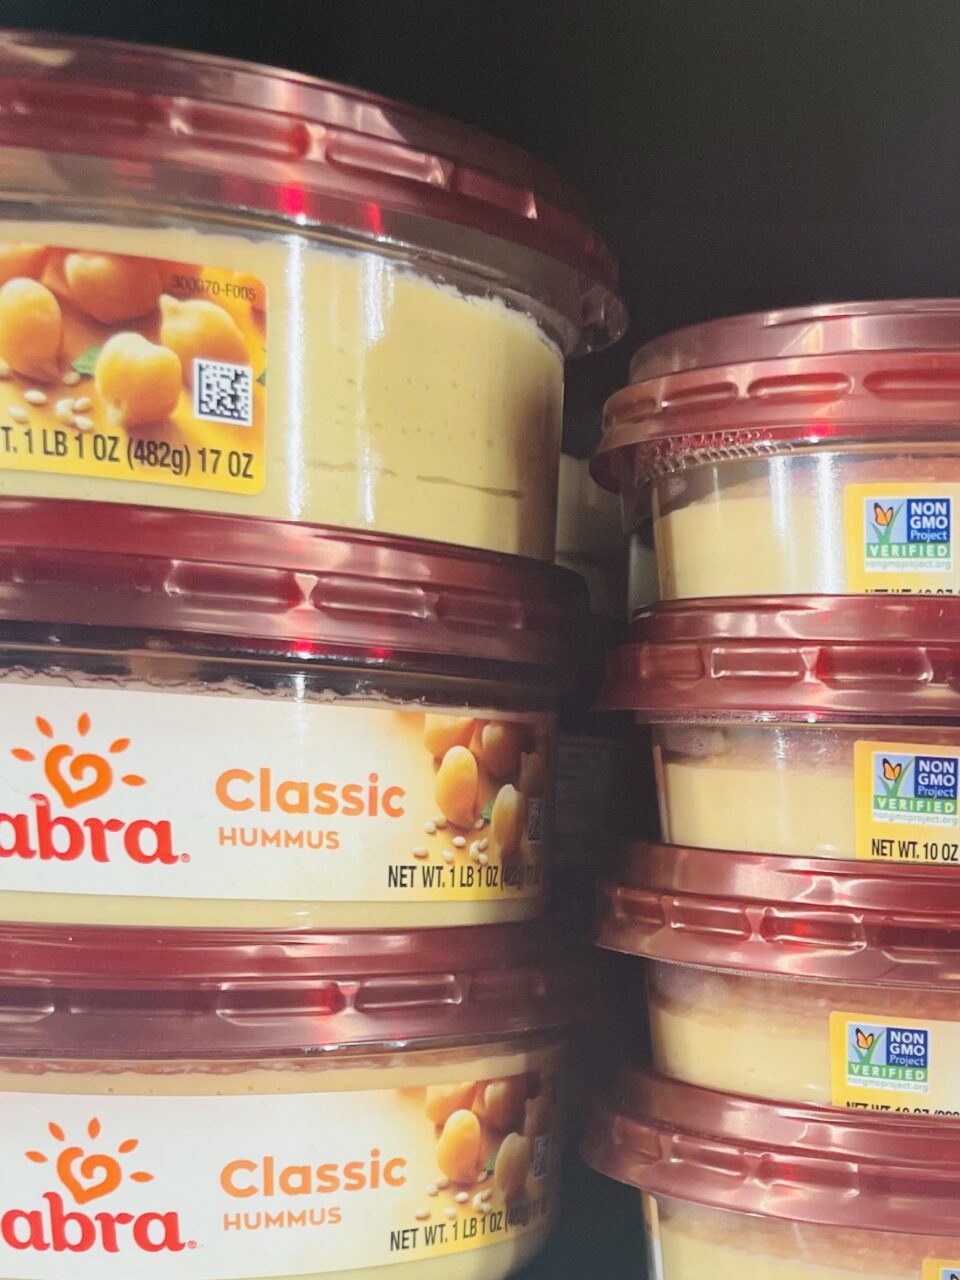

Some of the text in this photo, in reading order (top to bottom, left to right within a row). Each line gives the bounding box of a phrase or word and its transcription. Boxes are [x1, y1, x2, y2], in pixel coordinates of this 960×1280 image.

[42, 430, 254, 479] LB OZ (482g) 17 OZ
[910, 502, 947, 515] NON
[910, 515, 948, 530] GMO
[910, 529, 948, 543] Project
[869, 544, 948, 557] VERIFIED
[919, 760, 954, 773] NON
[918, 774, 955, 787] GMO
[215, 768, 406, 818] Classic
[917, 785, 954, 799] Project
[877, 797, 955, 813] VERIFIED
[0, 793, 182, 865] abra
[218, 826, 340, 850] HUMMUS
[872, 838, 894, 857] NET
[898, 840, 920, 859] WT.
[923, 842, 938, 860] 10
[942, 844, 958, 861] OZ
[388, 865, 445, 888] NET WT.
[890, 1031, 925, 1044] NON
[889, 1043, 925, 1056] GMO
[889, 1055, 925, 1067] Project
[851, 1064, 925, 1080] VERIFIED
[220, 1148, 408, 1198] Classic
[1, 1191, 186, 1253] abra
[223, 1206, 342, 1231] HUMMUS
[390, 1228, 419, 1251] NET
[424, 1223, 448, 1246] WT.
[463, 1217, 478, 1239] LB
